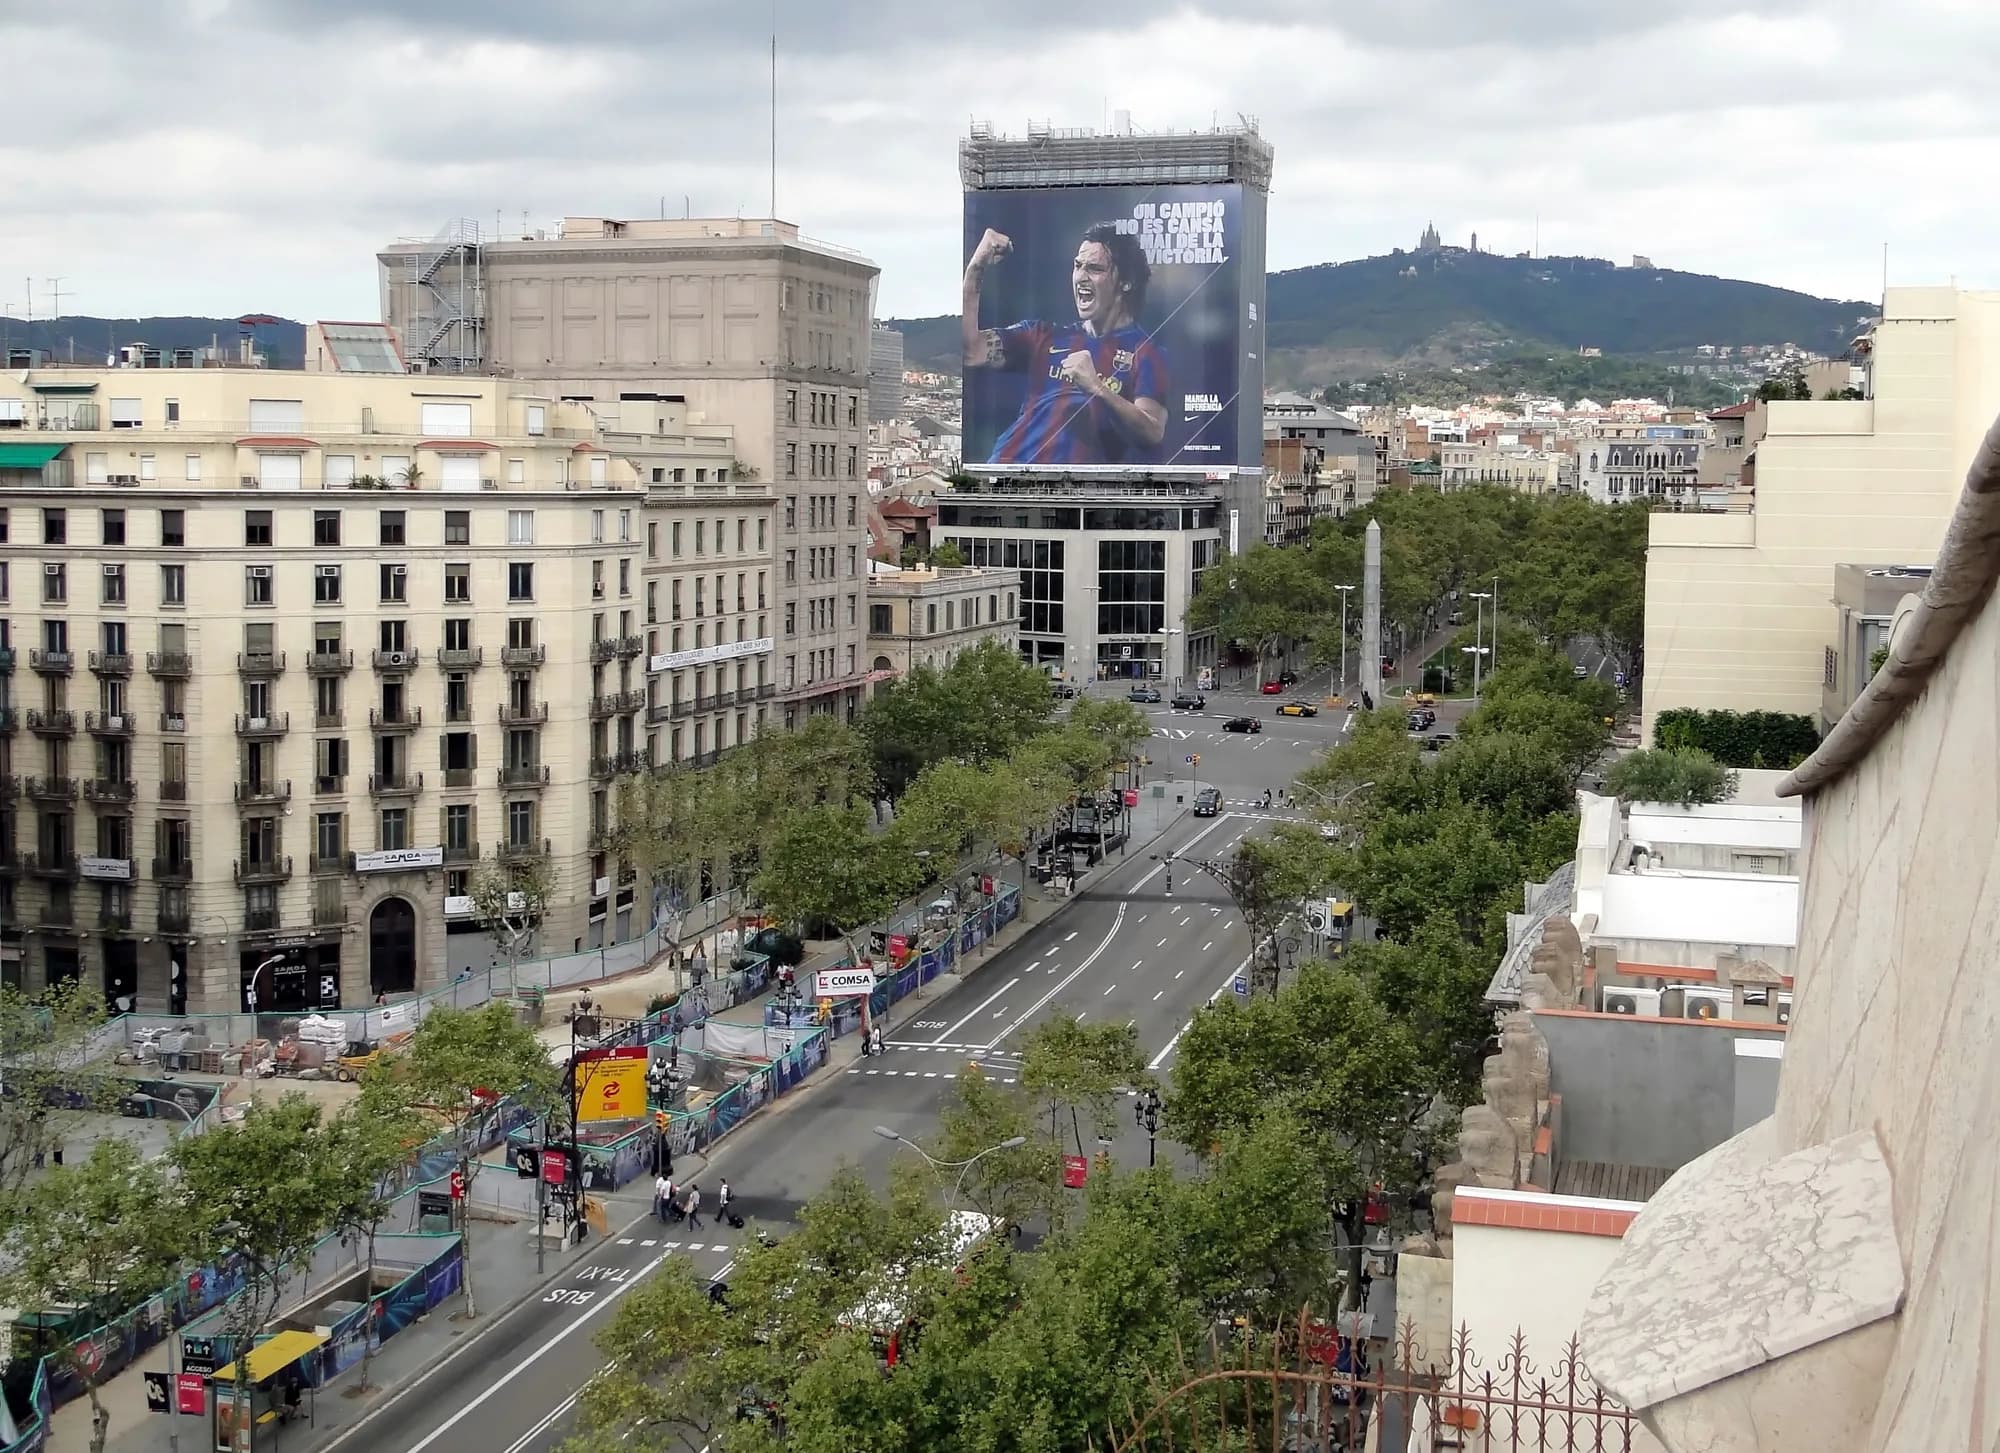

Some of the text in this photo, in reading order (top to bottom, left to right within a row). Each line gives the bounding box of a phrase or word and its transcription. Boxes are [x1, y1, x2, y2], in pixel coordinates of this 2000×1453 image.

[1133, 200, 1225, 220] UN CAMPIÓ
[1115, 217, 1225, 235] NO ES CANSA
[1140, 231, 1224, 250] MAI DE LA
[384, 853, 421, 863] SAMOA
[831, 975, 870, 986] COMSA
[912, 1020, 948, 1029] BUS
[576, 1265, 631, 1282] TAXI
[542, 1288, 596, 1305] BUS
[186, 1365, 212, 1374] ACCESO
